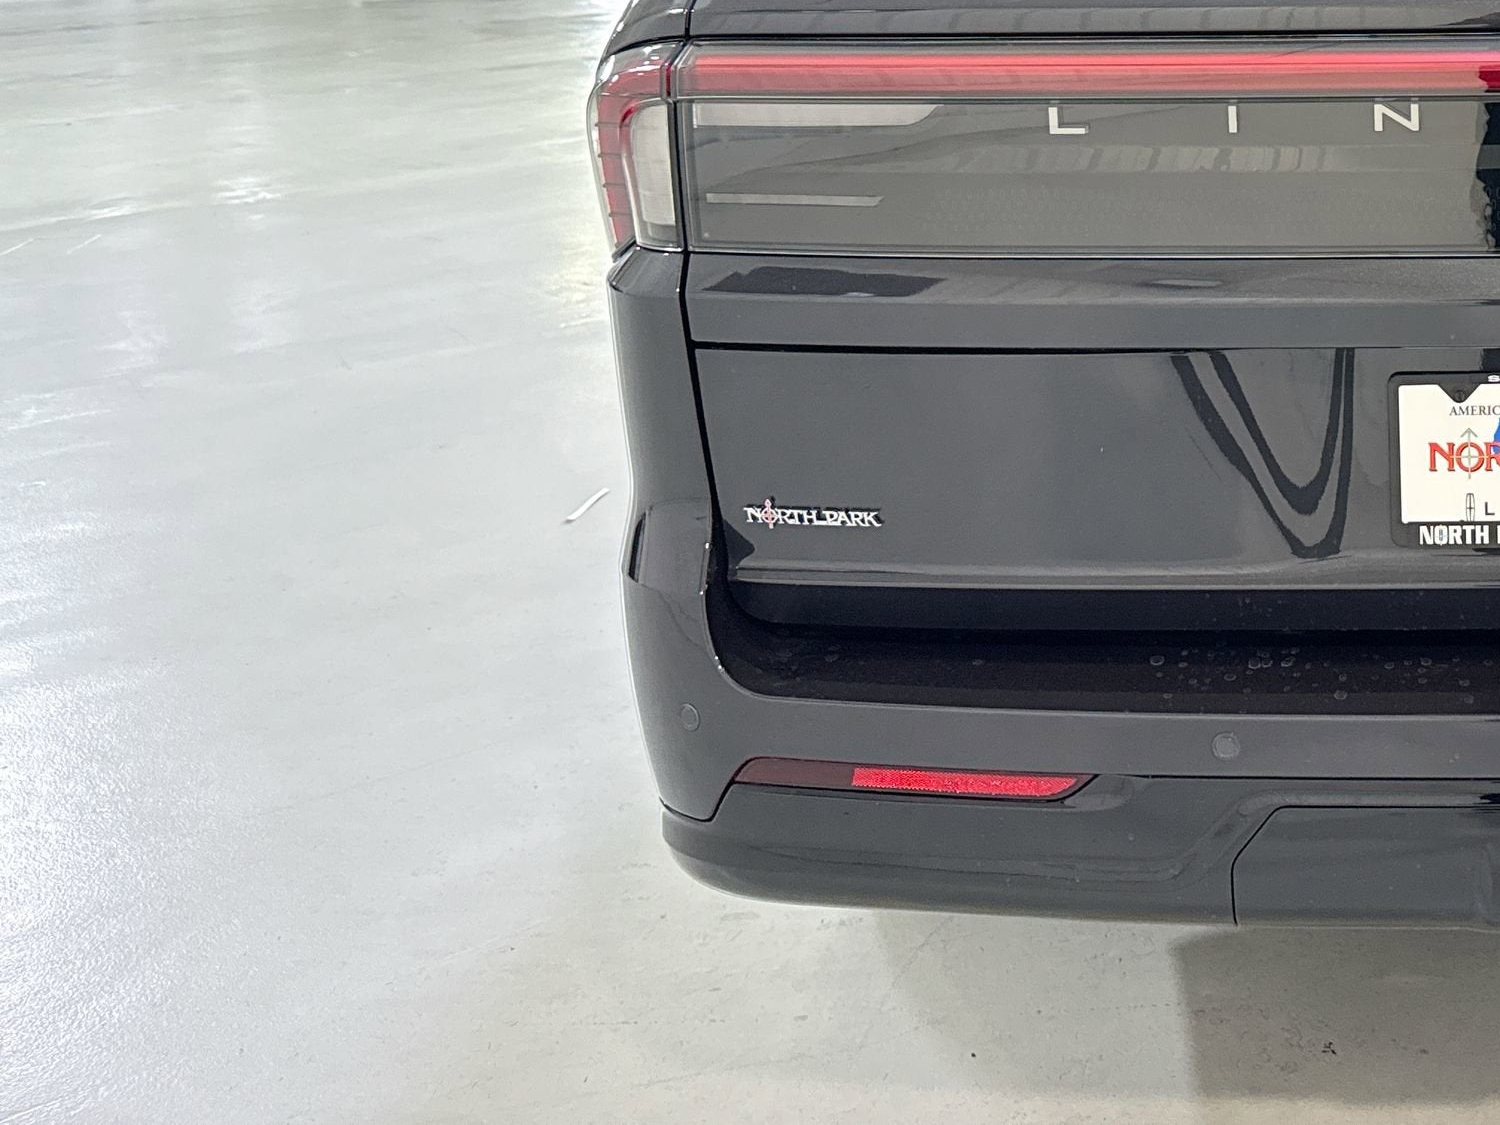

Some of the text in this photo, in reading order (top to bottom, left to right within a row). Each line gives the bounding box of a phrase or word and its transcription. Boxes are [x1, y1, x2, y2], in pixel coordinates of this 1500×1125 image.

[743, 505, 882, 526] NORTH PARK
[1419, 524, 1489, 545] NORTH
